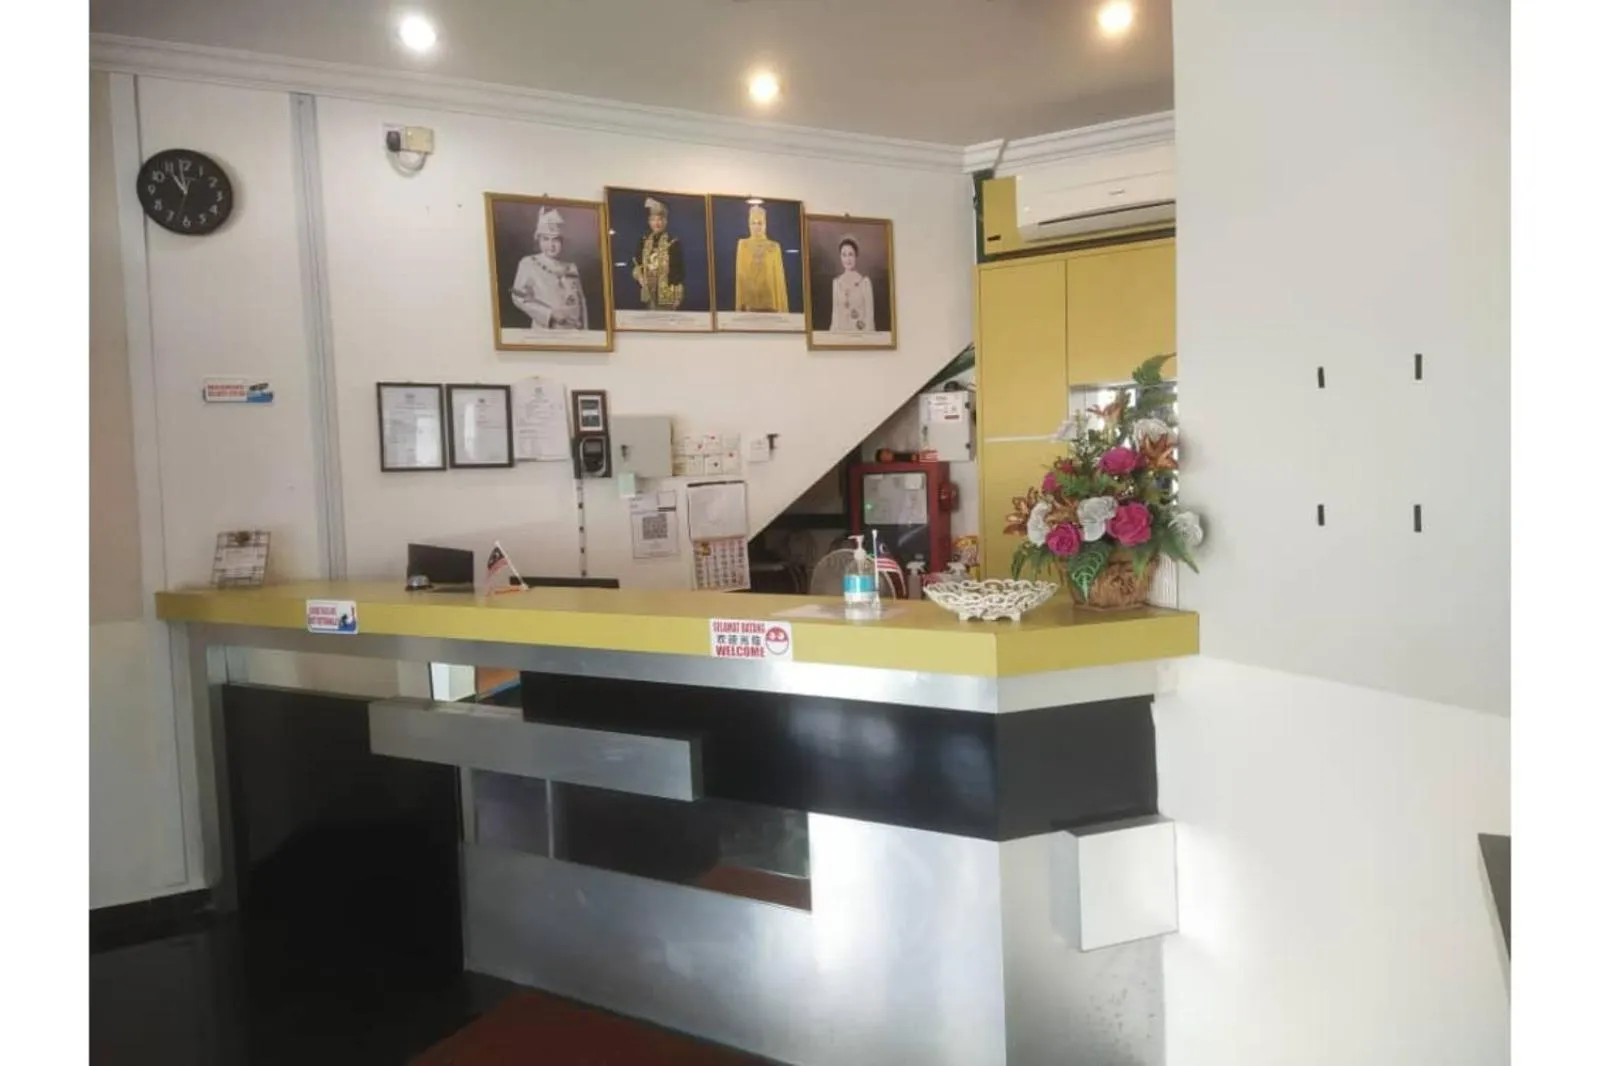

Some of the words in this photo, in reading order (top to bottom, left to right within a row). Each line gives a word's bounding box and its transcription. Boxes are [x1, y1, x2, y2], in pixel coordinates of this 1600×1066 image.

[152, 170, 165, 183] 10
[199, 165, 204, 177] 1
[208, 177, 218, 188] 2
[147, 184, 156, 195] 9
[216, 190, 223, 202] 3
[154, 199, 163, 211] 8
[208, 204, 218, 216] 4
[166, 211, 175, 223] 7
[182, 215, 192, 229] 6
[198, 213, 207, 225] 5
[713, 622, 739, 632] SELAMAT
[741, 623, 765, 633] DATANG
[716, 646, 765, 657] WELCOME
